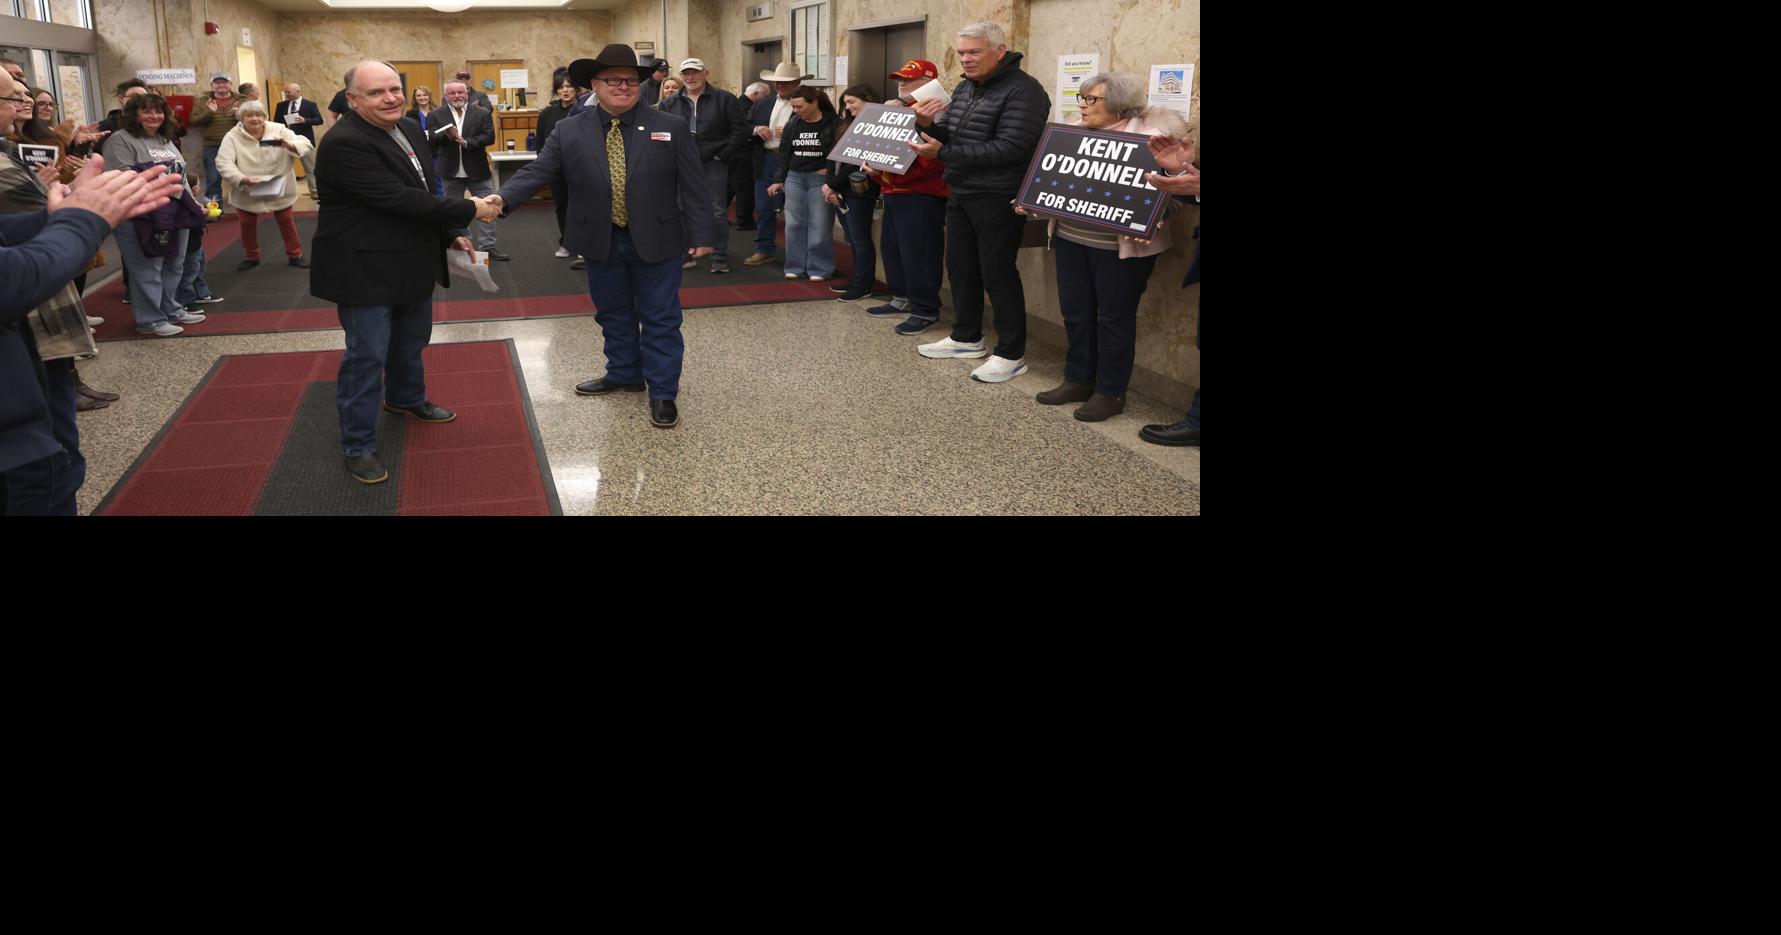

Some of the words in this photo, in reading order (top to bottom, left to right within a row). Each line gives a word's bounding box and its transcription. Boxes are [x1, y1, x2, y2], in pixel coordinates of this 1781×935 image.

[878, 111, 915, 126] KENT
[842, 147, 861, 158] FOR
[860, 150, 899, 165] SHERIFF
[1077, 137, 1138, 162] KENT
[1036, 192, 1065, 210] FOR
[1065, 198, 1134, 223] SHERIFF
